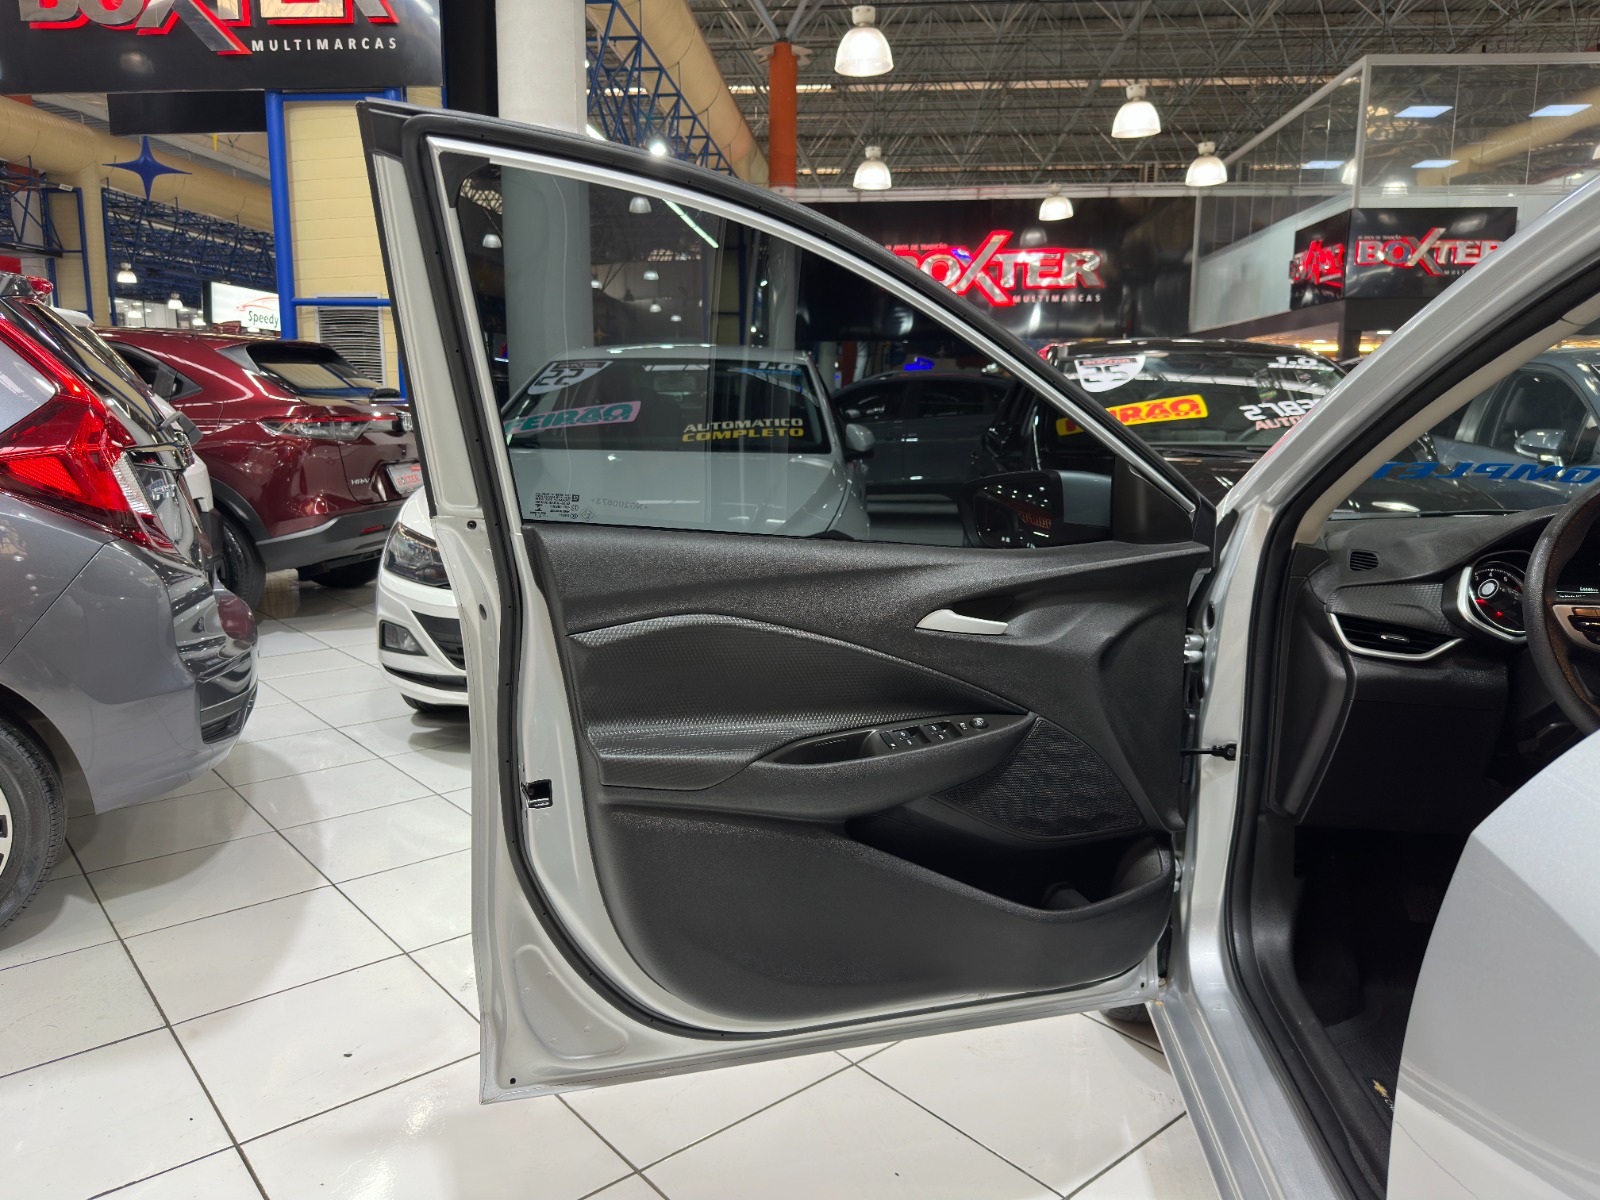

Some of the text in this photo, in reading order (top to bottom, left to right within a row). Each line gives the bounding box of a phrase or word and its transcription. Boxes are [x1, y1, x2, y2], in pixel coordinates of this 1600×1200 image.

[251, 37, 398, 51] MULTIMARCAS
[896, 229, 1104, 306] OXTER
[1012, 294, 1102, 304] MULTIMARCAS
[248, 310, 279, 328] Speedy
[533, 369, 586, 386] 22
[504, 403, 633, 434] FEIRÃO
[682, 427, 804, 442] COMPLETO
